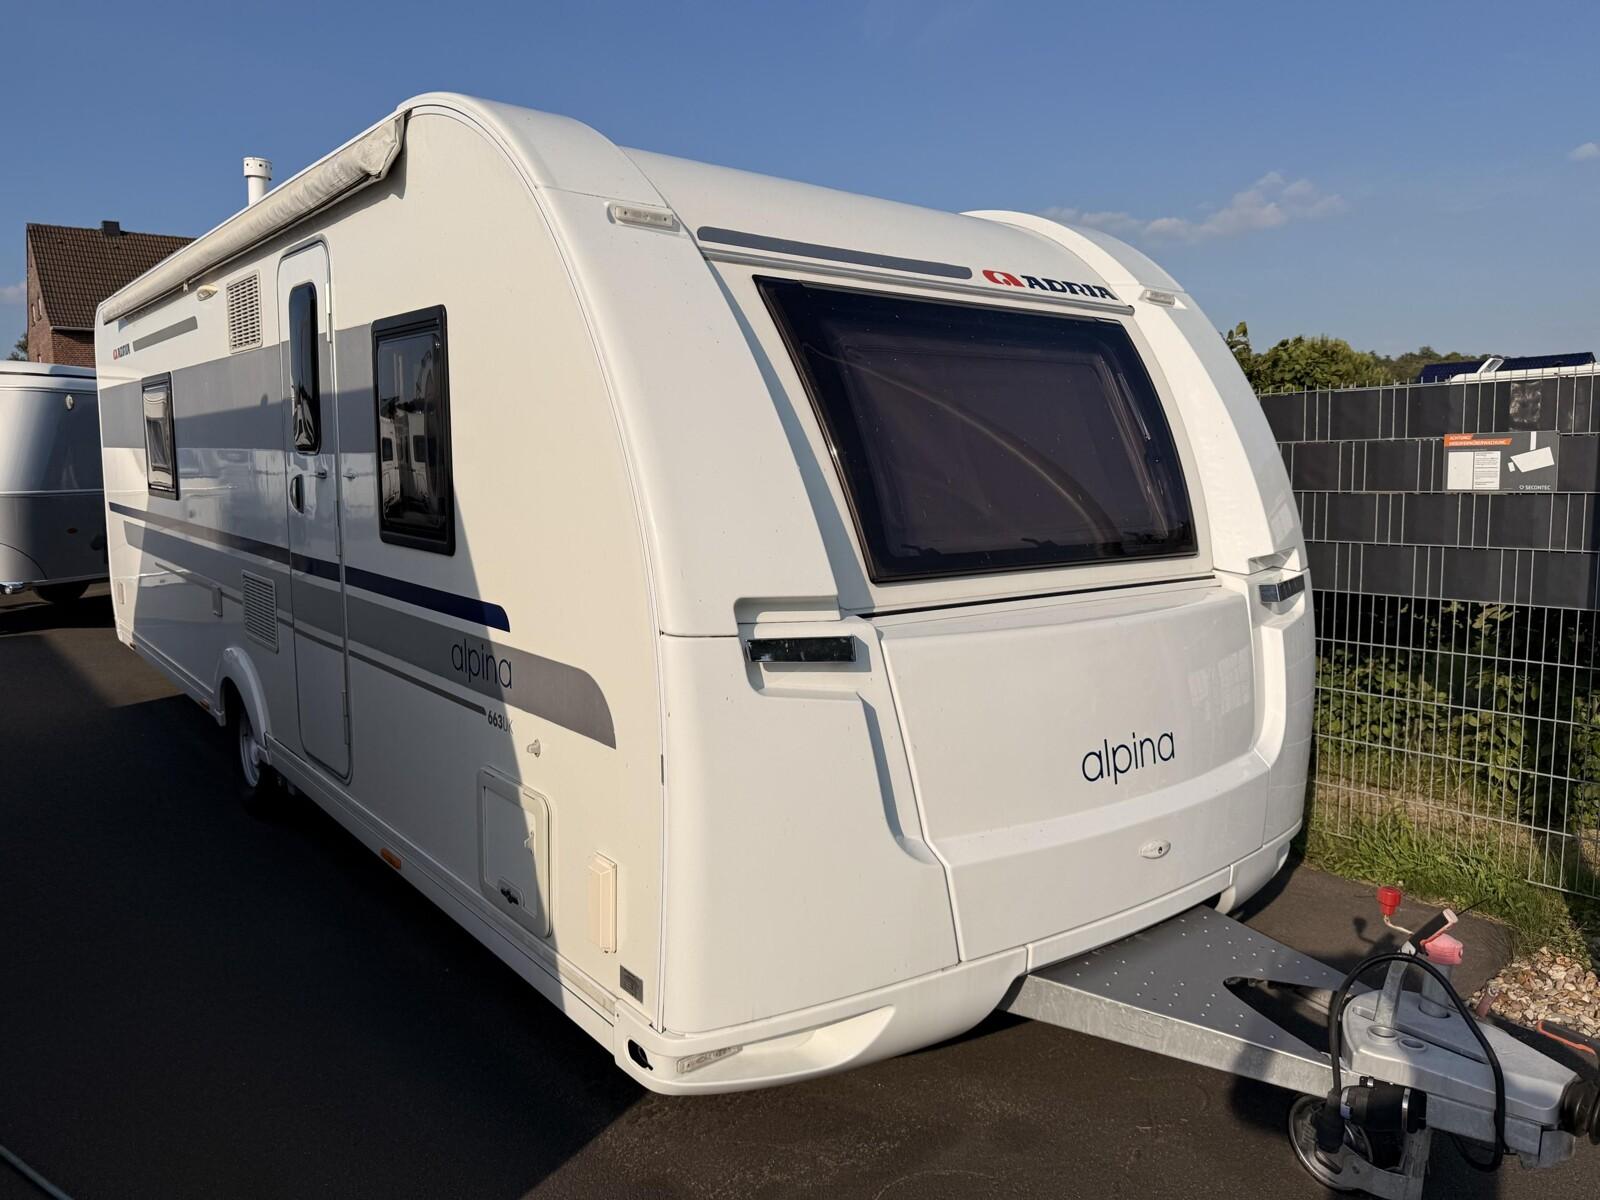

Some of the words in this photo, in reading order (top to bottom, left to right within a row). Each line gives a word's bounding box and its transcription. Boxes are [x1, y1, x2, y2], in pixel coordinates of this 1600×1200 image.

[1020, 274, 1119, 301] ADRIA
[451, 639, 512, 689] alpina
[1082, 731, 1175, 785] alpina
